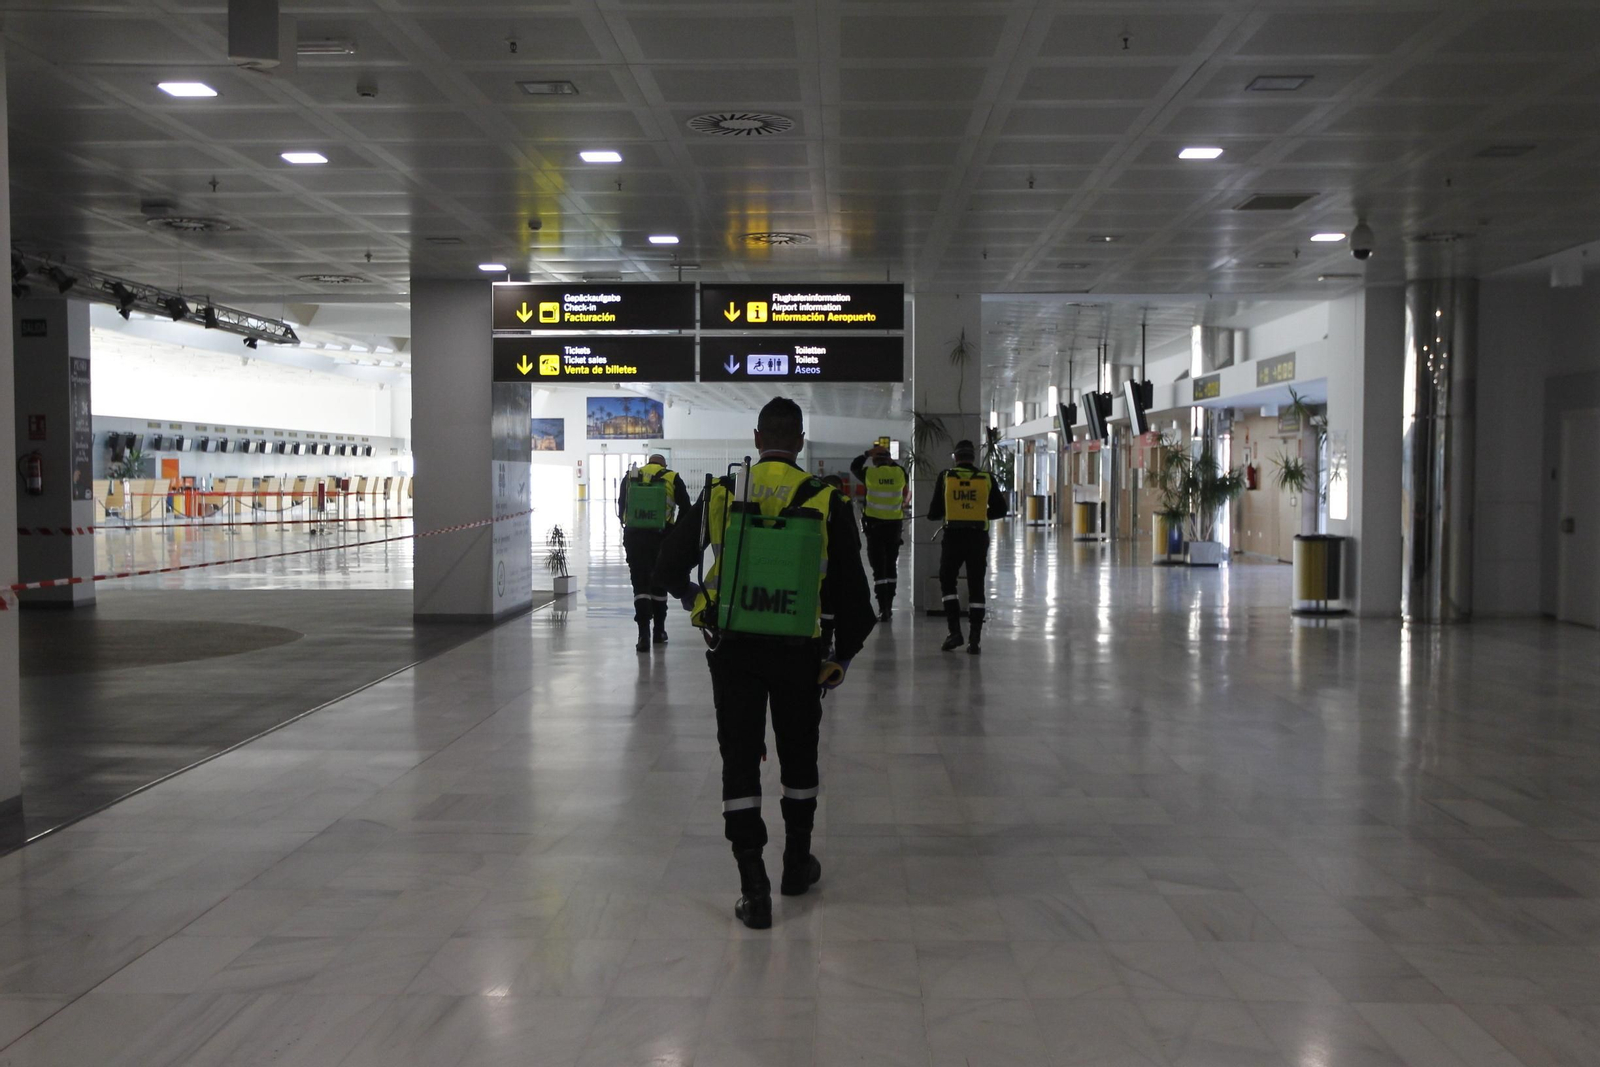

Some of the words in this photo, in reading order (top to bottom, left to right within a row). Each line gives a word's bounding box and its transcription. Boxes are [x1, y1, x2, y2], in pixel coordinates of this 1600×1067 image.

[772, 293, 851, 304] Flughafeninformation
[564, 303, 597, 312] Check-in
[772, 303, 798, 312] Airport
[564, 312, 616, 322] Facturación
[772, 312, 825, 322] Información
[827, 312, 877, 323] Aeropuerto
[564, 346, 591, 355] Tickets
[794, 346, 827, 355] Toiletten
[564, 355, 587, 364] Ticket
[587, 355, 607, 364] sales
[794, 355, 819, 364] Toilets
[564, 364, 590, 374] Venta
[591, 364, 604, 374] de
[605, 364, 638, 374] billetes
[795, 365, 821, 374] Aseos
[878, 478, 895, 486] UME
[751, 483, 792, 500] UME
[952, 489, 978, 502] UME
